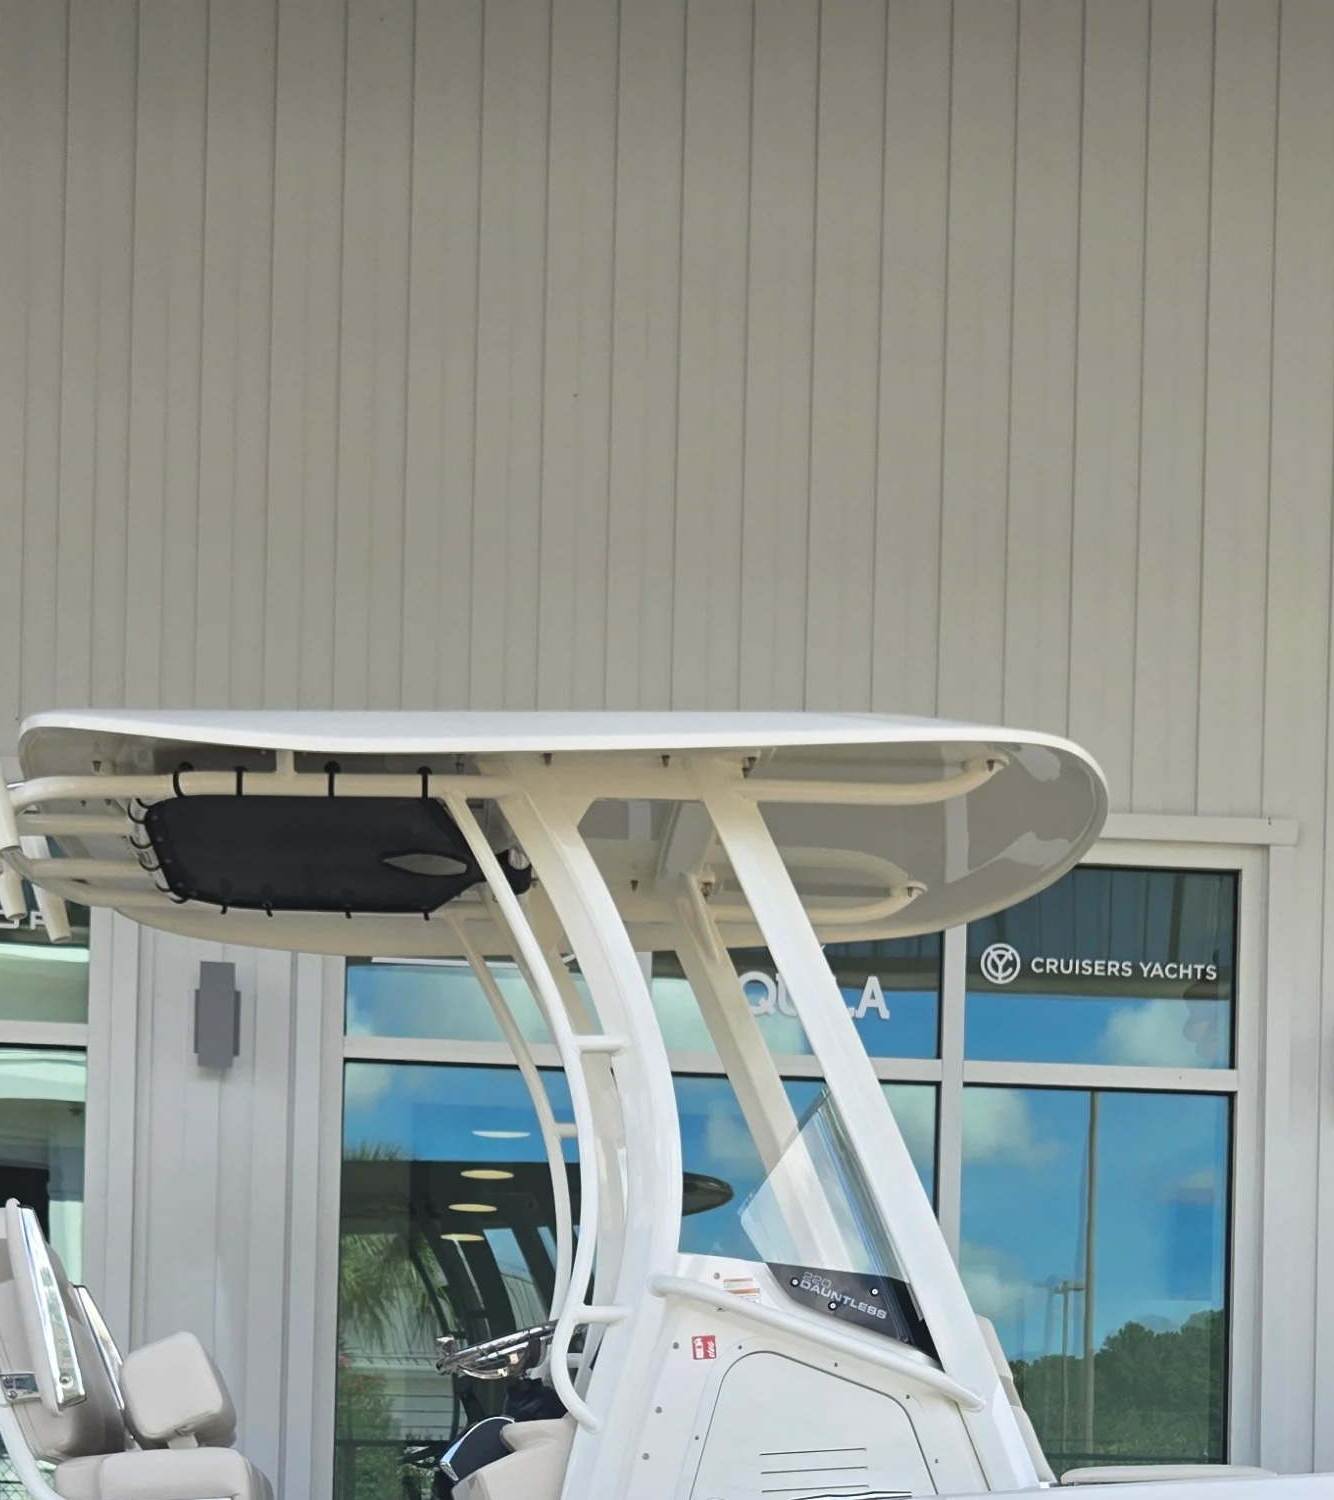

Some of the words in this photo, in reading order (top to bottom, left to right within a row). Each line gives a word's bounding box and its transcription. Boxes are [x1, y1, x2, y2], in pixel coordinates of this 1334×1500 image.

[1030, 957, 1133, 977] CRUISERS
[1139, 962, 1217, 980] YACHTS
[802, 1271, 832, 1289] 220
[799, 1280, 887, 1320] DAUNTLESS
